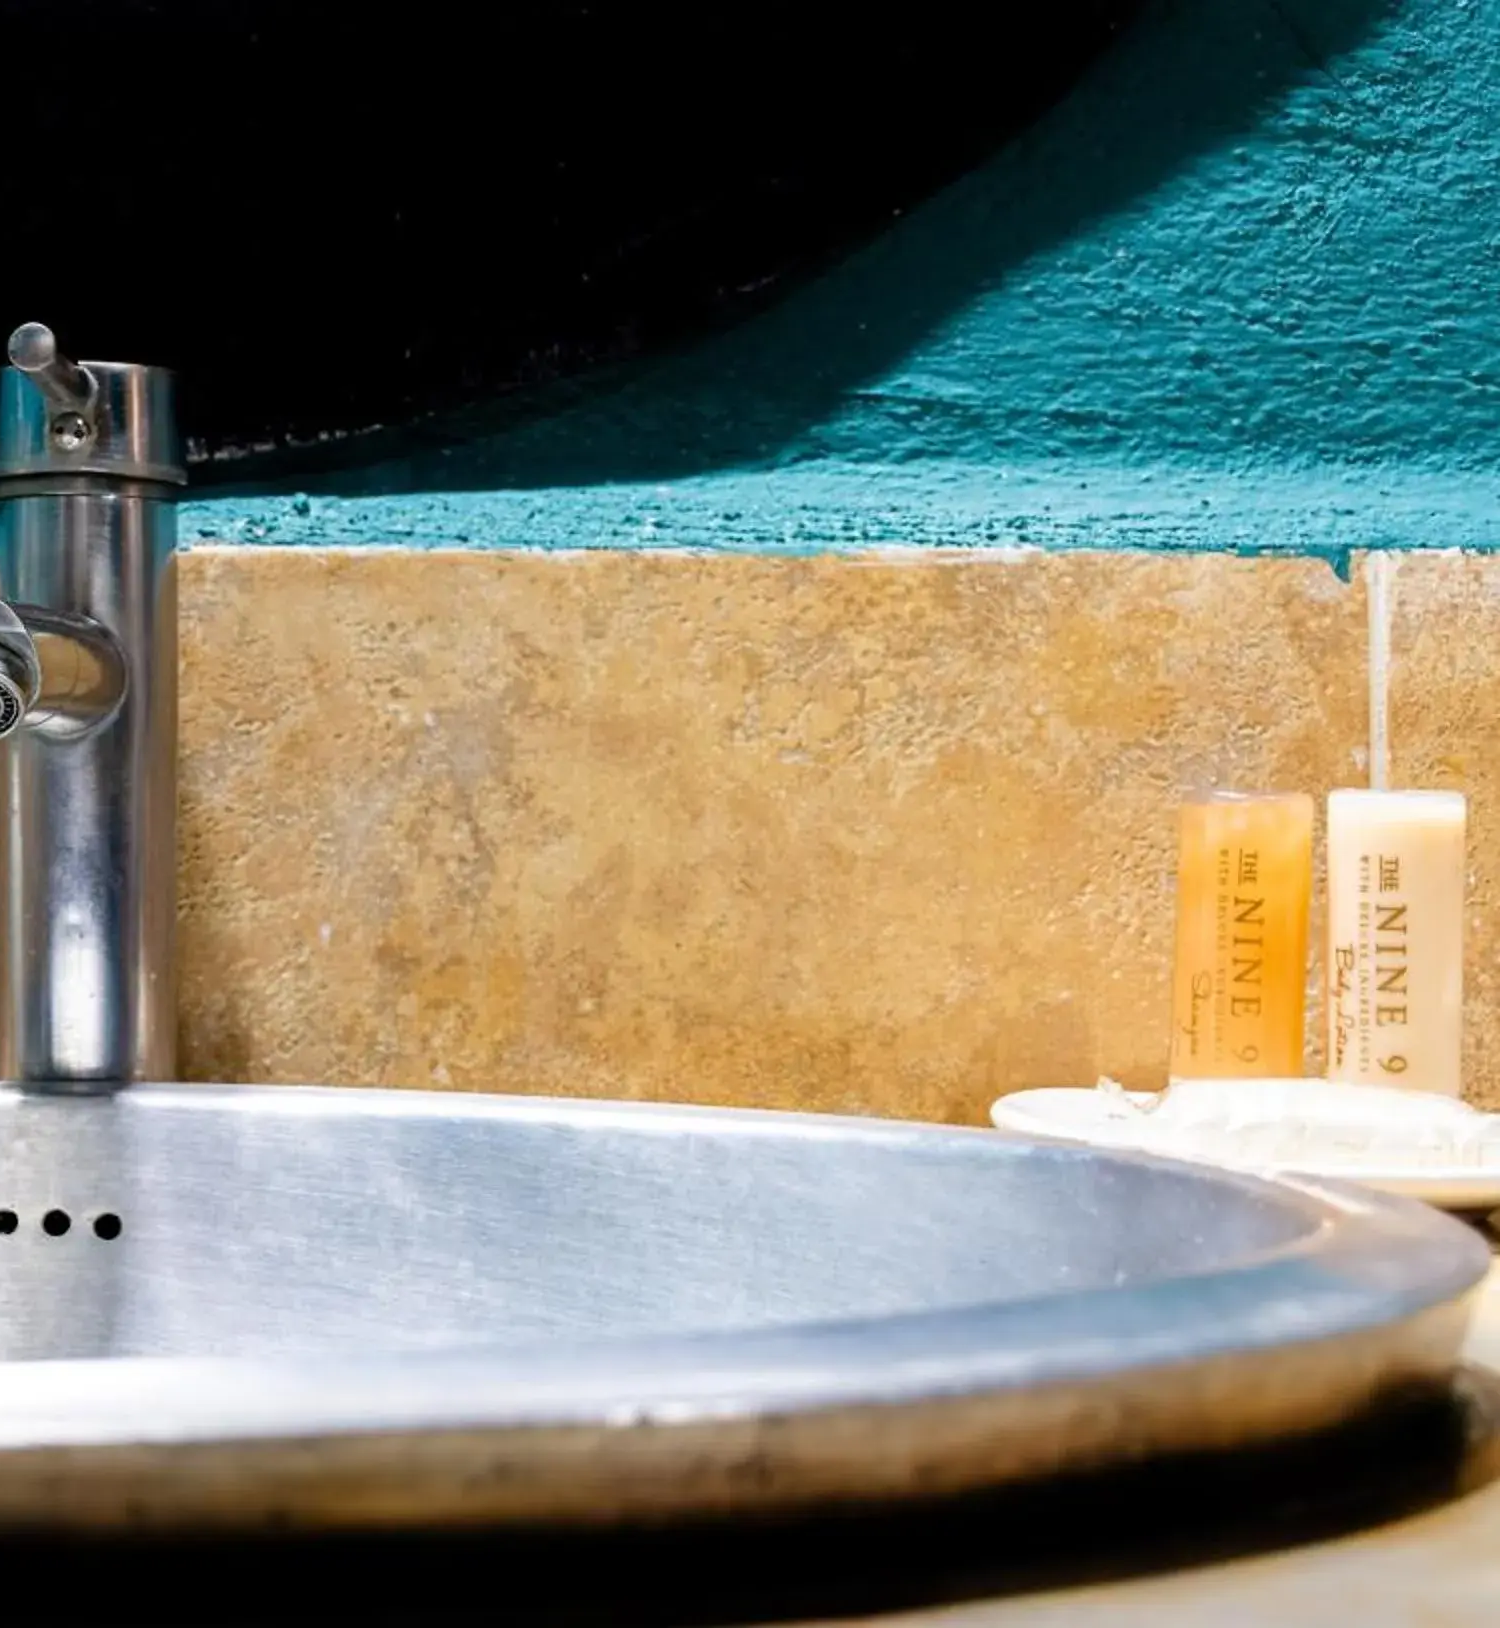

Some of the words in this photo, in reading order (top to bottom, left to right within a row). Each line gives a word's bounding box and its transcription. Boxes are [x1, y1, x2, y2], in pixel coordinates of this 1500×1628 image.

[1242, 851, 1258, 885] THE
[1359, 855, 1370, 894] WITH
[1383, 856, 1399, 892] THE
[1231, 897, 1265, 1018] NINE
[1331, 944, 1355, 999] Body
[1375, 904, 1407, 1027] NINE
[1232, 1044, 1260, 1064] 9
[1379, 1054, 1408, 1075] 9
